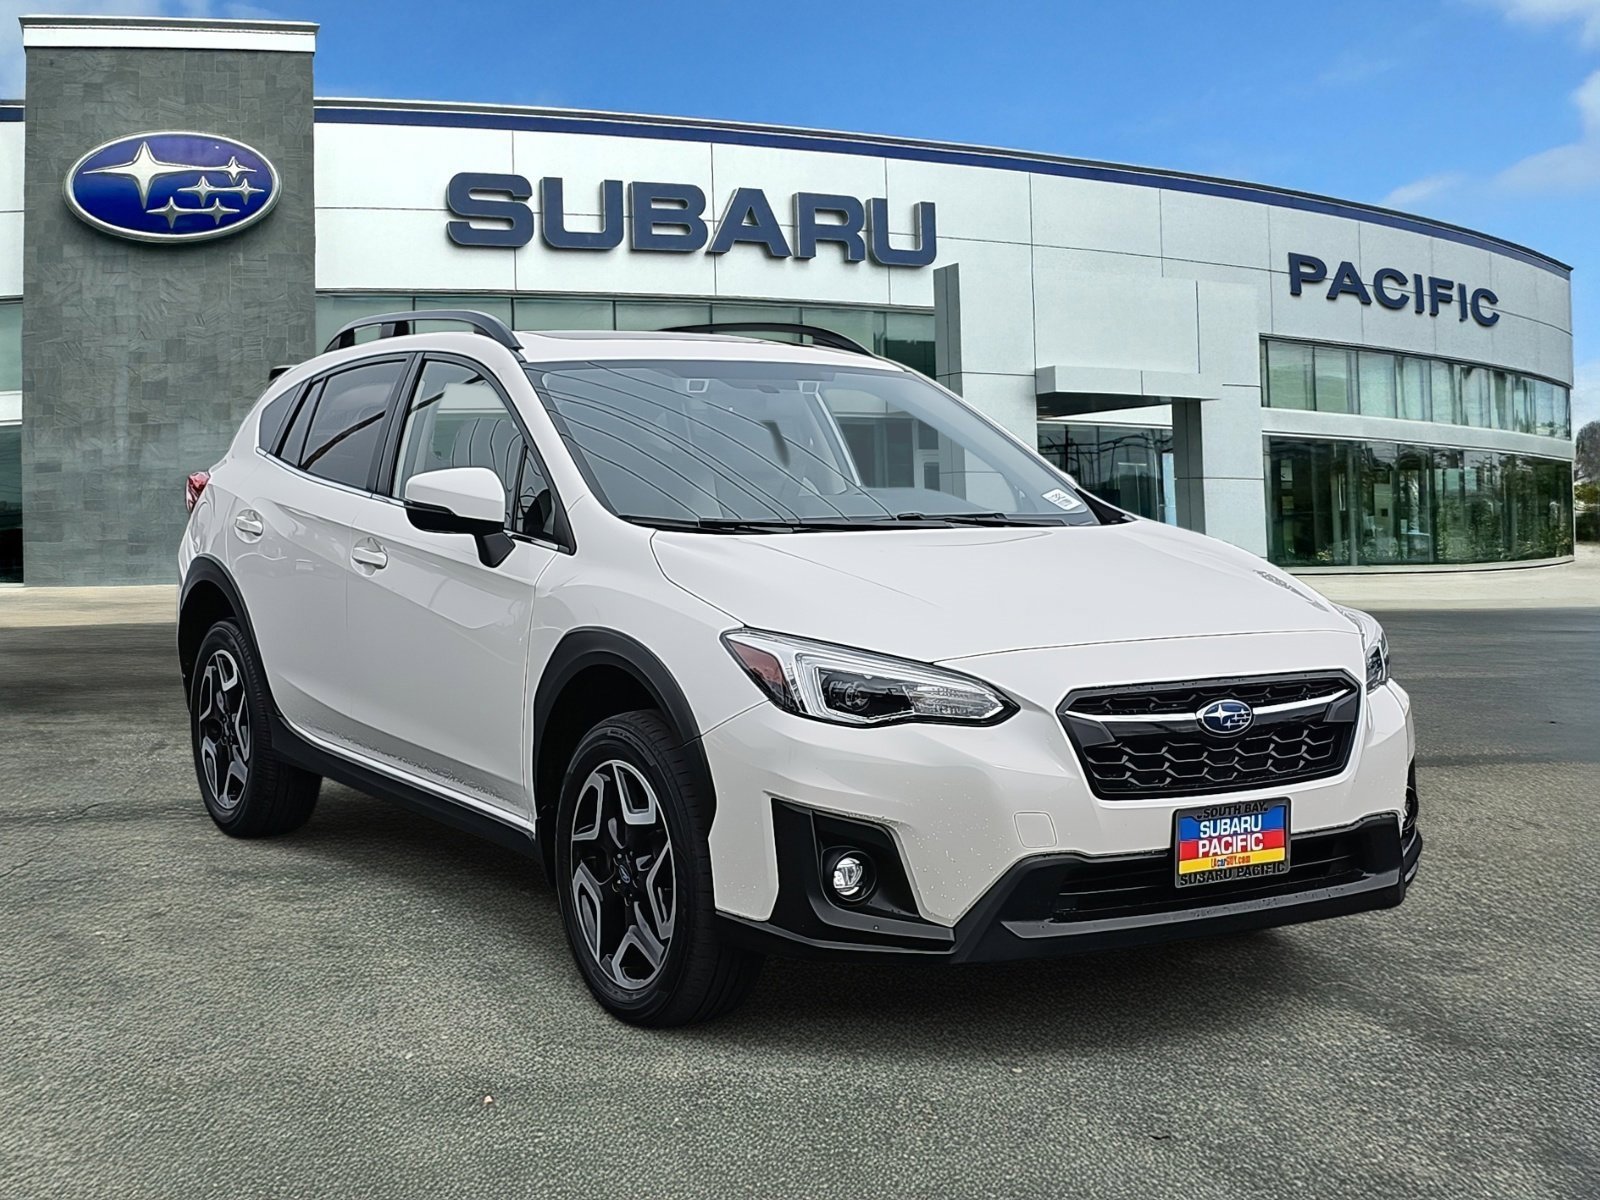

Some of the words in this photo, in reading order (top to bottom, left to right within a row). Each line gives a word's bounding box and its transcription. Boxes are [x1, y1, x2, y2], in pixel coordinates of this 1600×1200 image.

[446, 172, 936, 268] SUBARU
[1288, 252, 1500, 327] PACIFIC
[1203, 805, 1241, 819] SOUTH
[1244, 802, 1264, 813] BAY
[1200, 814, 1262, 838] SUBARU
[1198, 833, 1264, 858] PACIFIC
